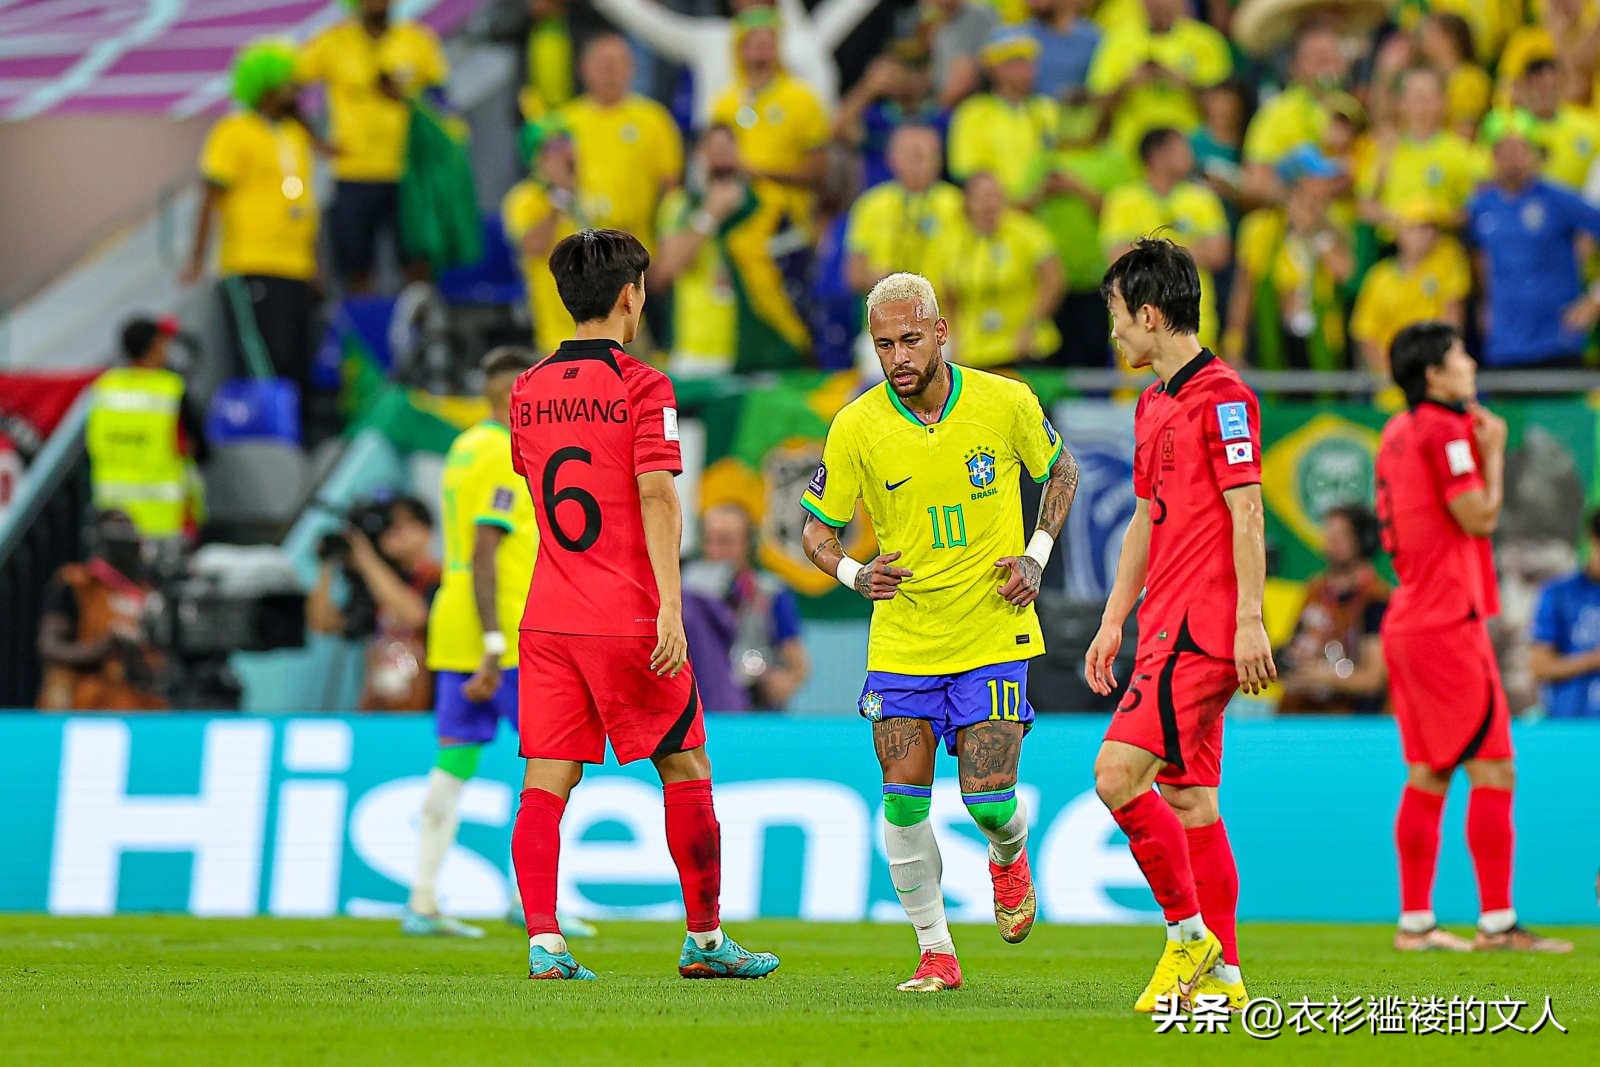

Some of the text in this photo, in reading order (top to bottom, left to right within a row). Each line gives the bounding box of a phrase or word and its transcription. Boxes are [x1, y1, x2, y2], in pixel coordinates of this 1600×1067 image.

[537, 398, 628, 424] HWANG
[542, 446, 603, 553] 6
[970, 487, 998, 501] BRASIL
[927, 503, 967, 549] 10
[987, 679, 1021, 721] 10
[1118, 673, 1153, 713] 5
[47, 717, 1166, 925] Hisense
